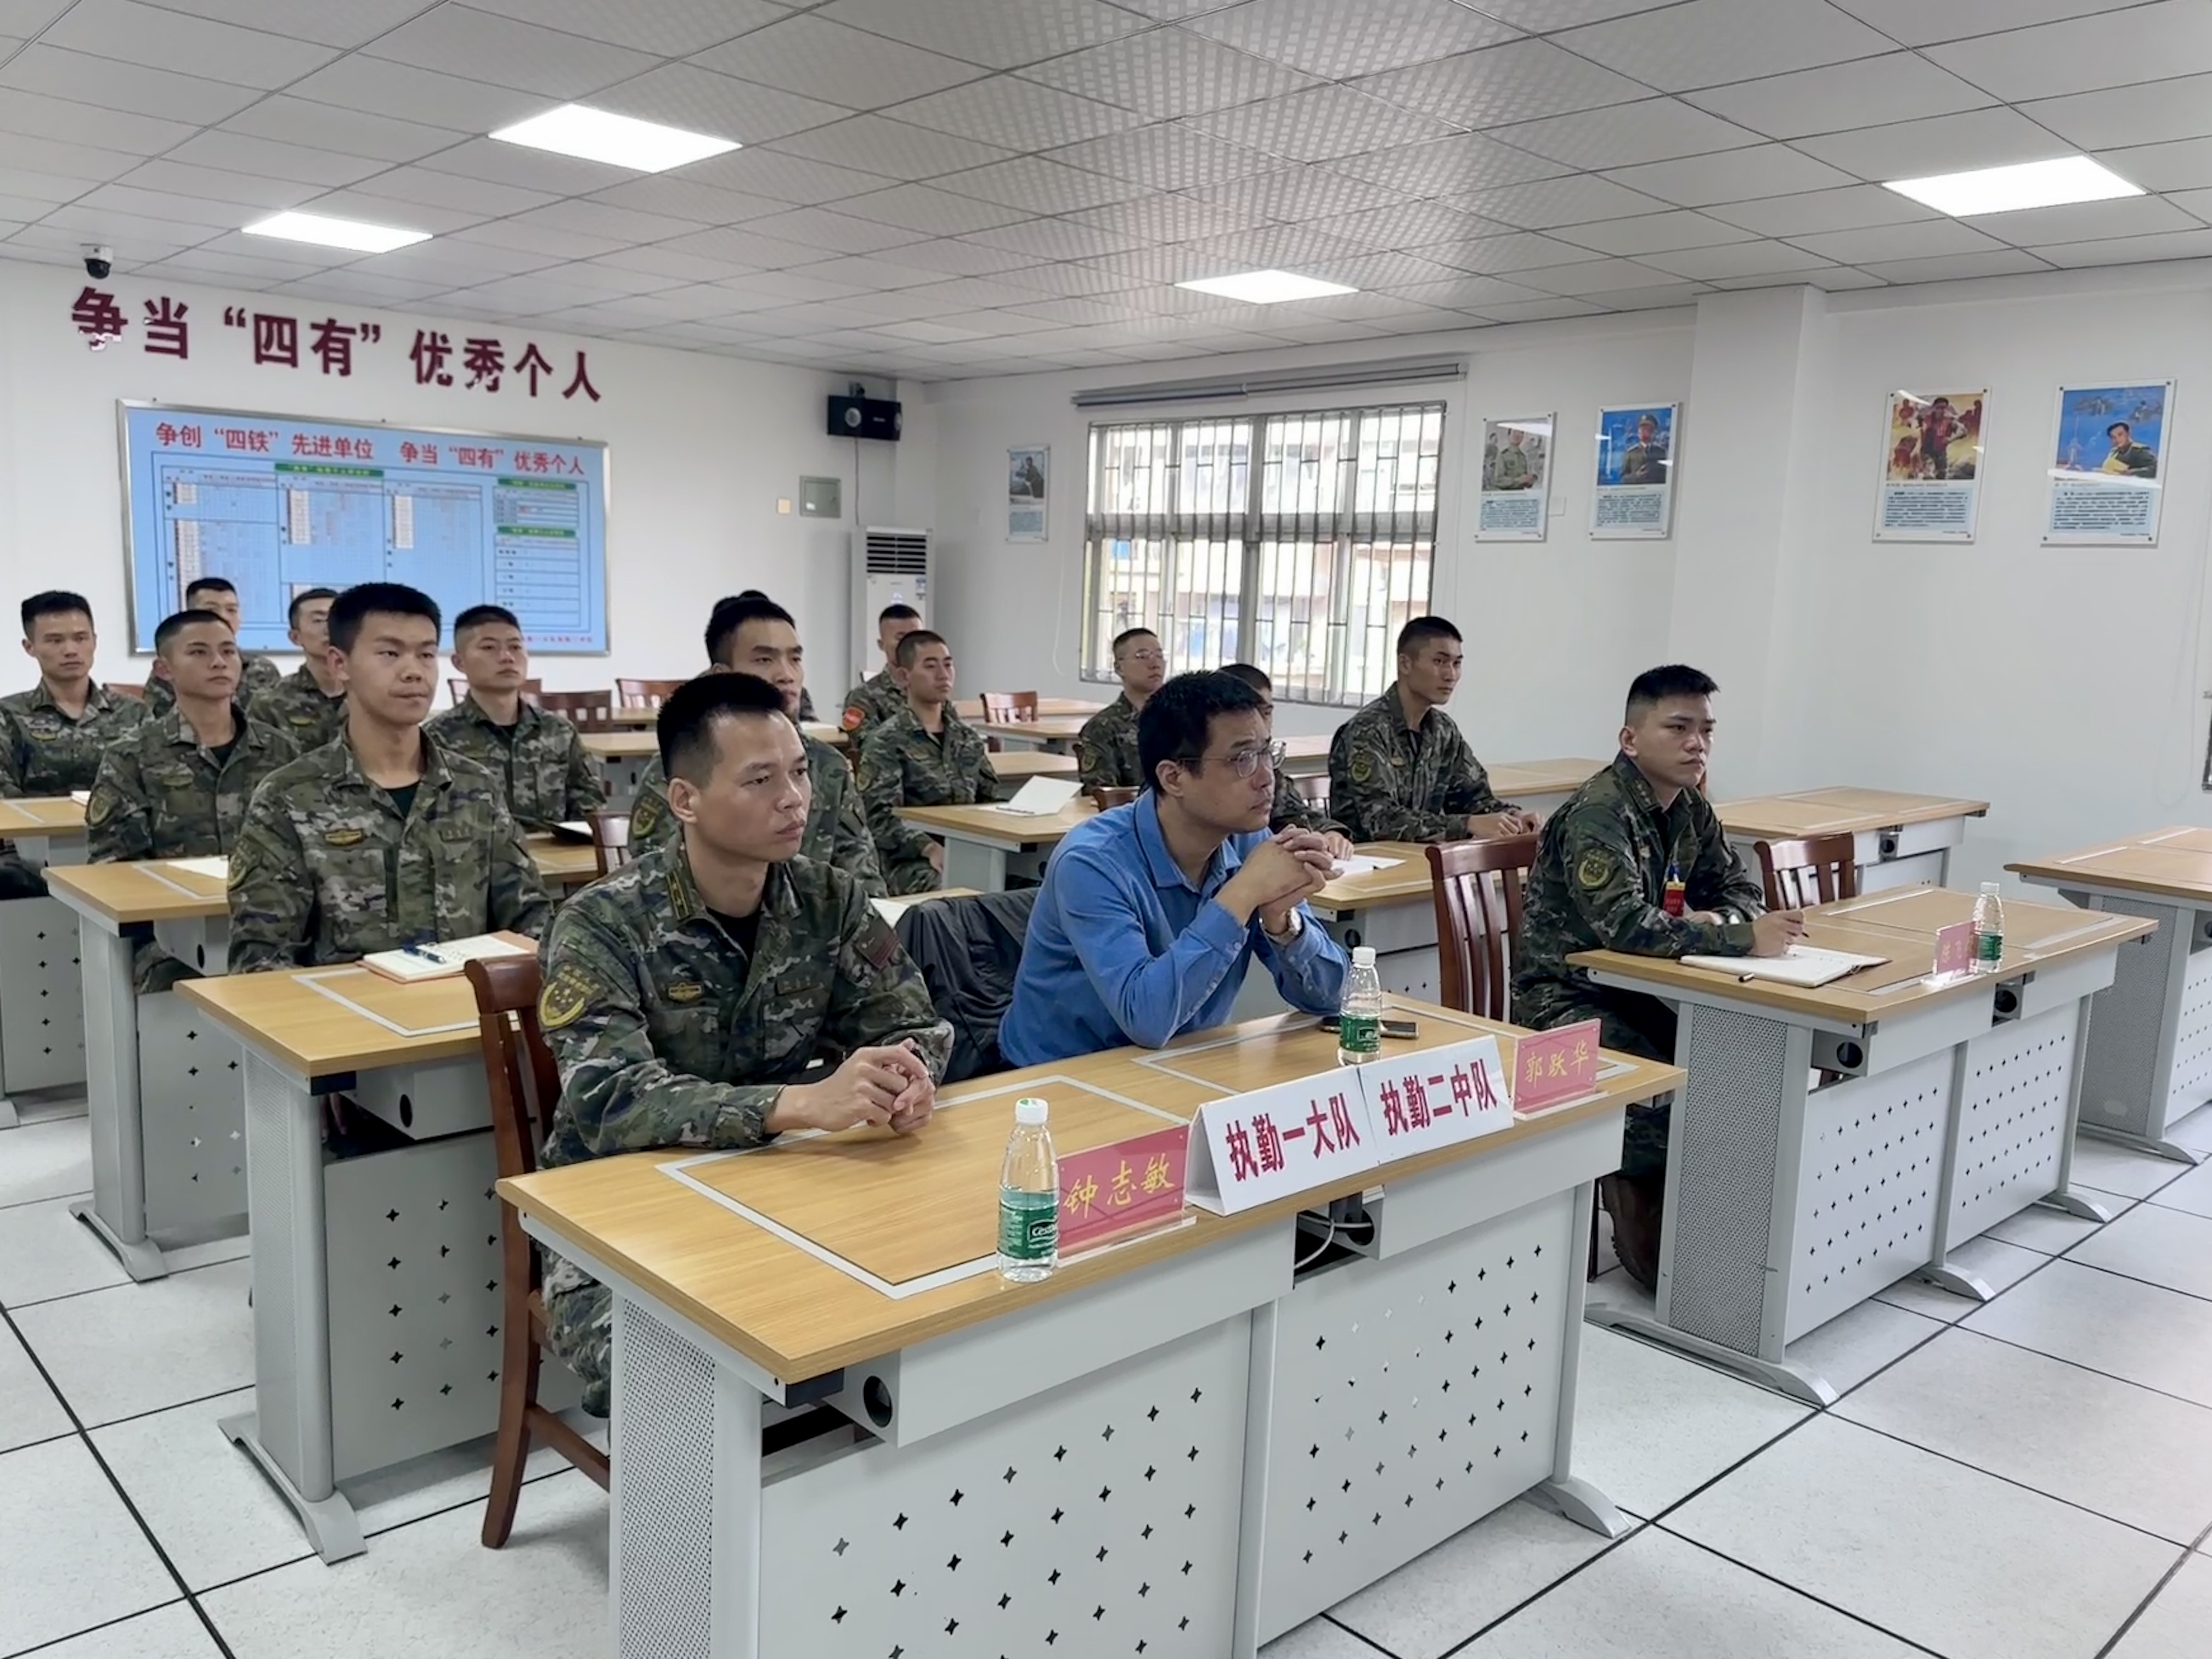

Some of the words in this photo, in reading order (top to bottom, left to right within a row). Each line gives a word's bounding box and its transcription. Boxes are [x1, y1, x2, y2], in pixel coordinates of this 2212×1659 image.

[1380, 1058, 1497, 1136] 执勤二中队
[1225, 1092, 1361, 1182] 执勤一大队
[1063, 1153, 1175, 1219] 钟志敏
